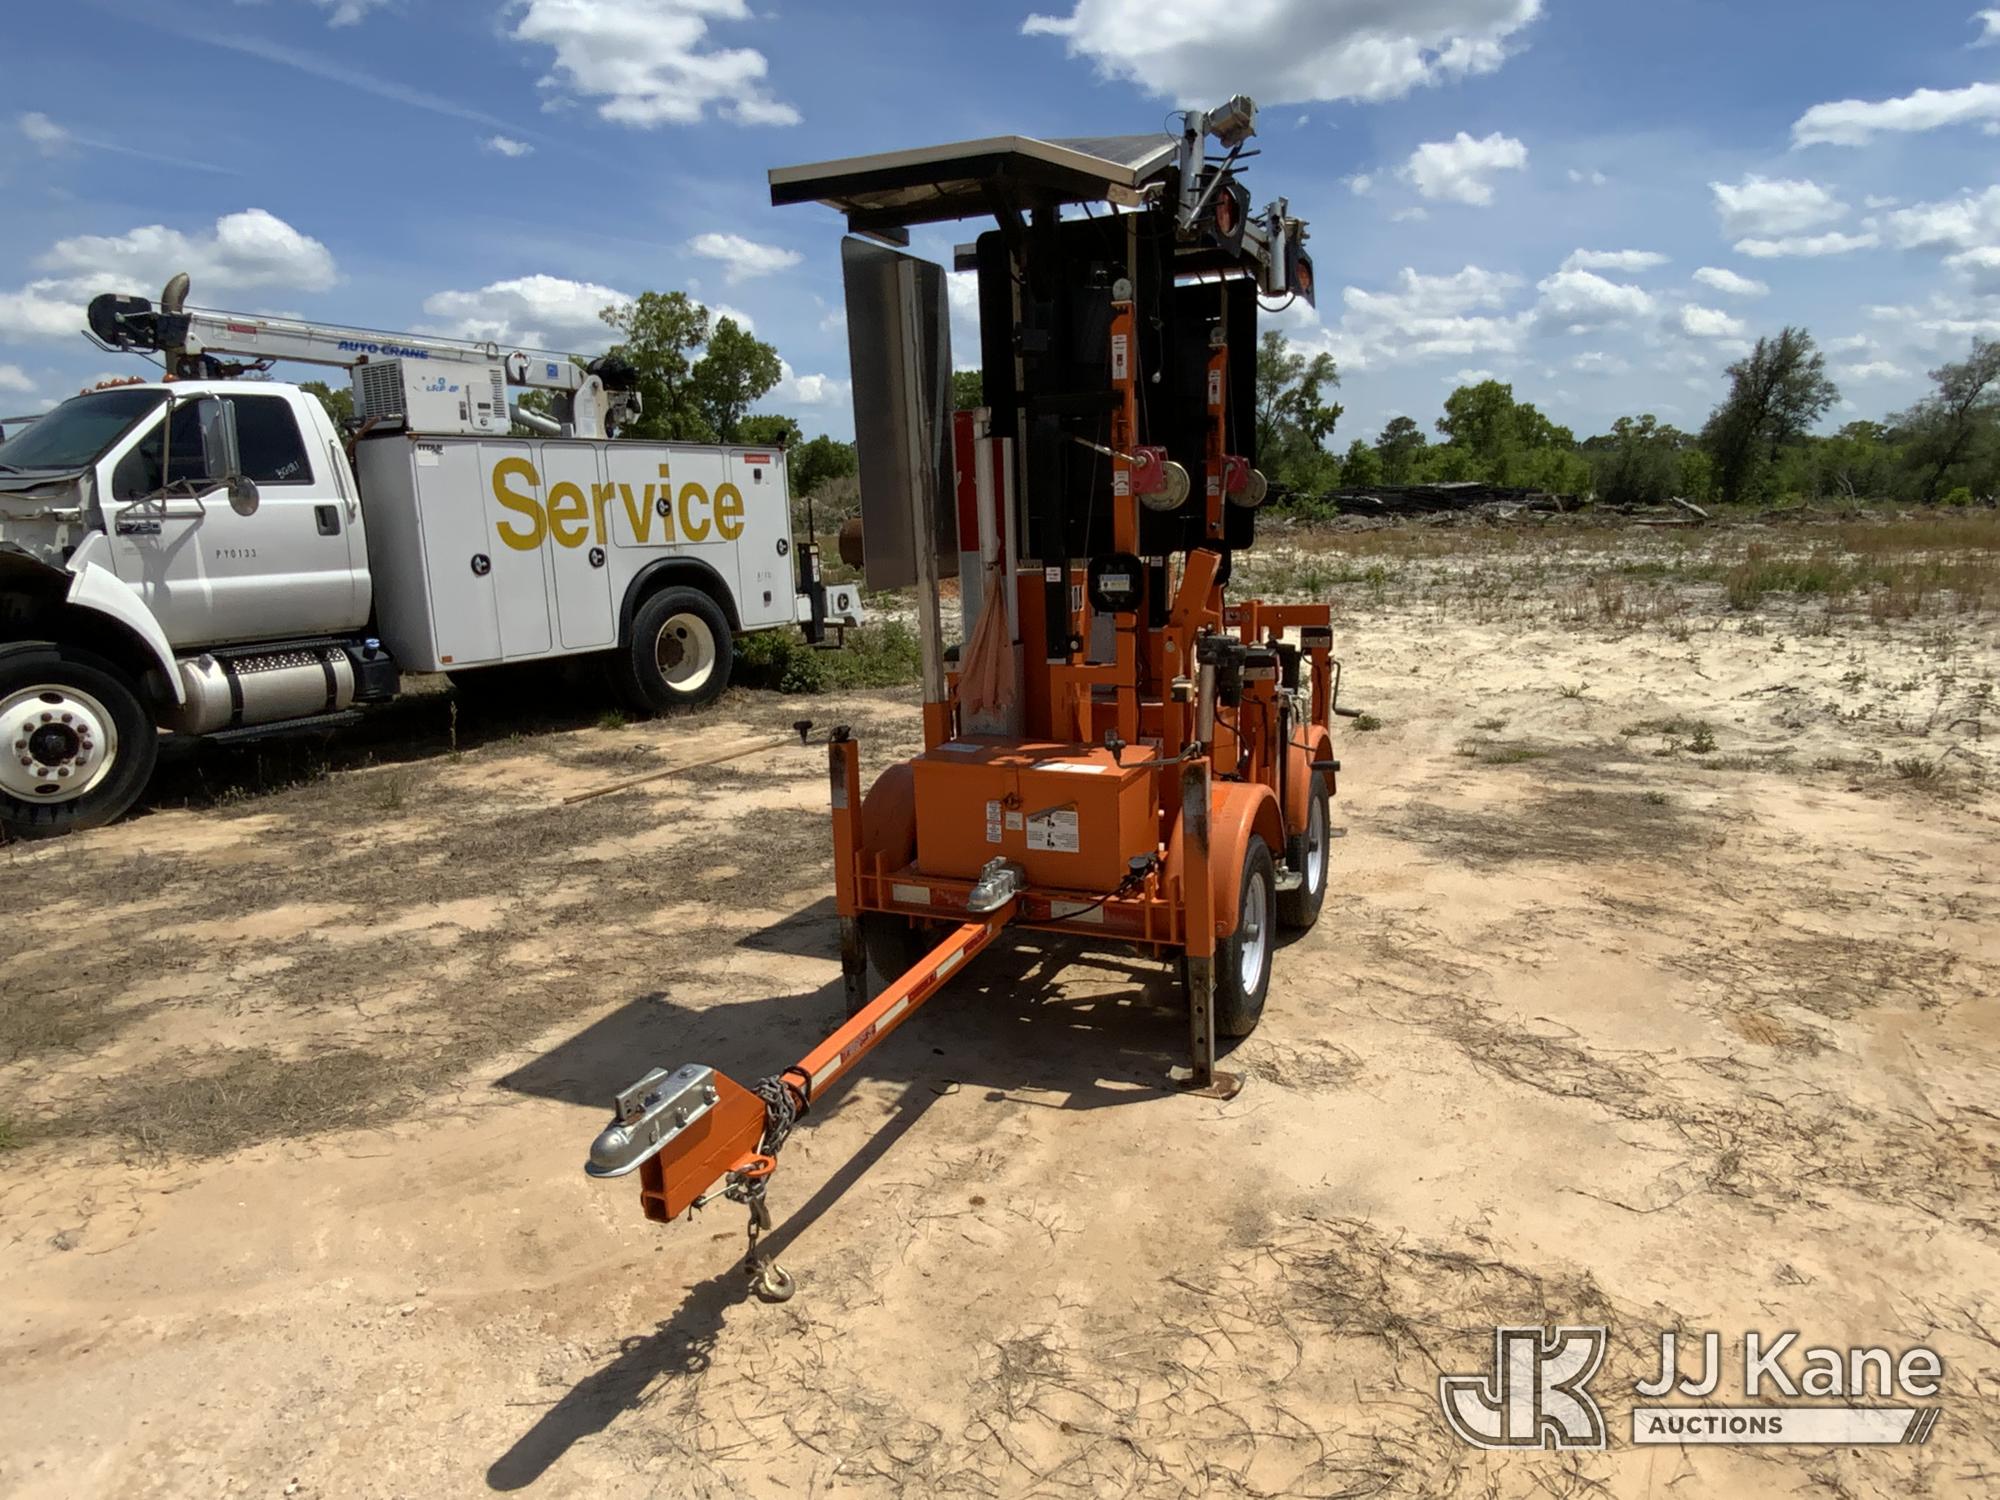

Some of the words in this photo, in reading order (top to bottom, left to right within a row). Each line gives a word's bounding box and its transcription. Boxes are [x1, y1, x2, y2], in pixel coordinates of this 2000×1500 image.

[338, 341, 379, 354] AUTO
[380, 345, 429, 359] CRANE
[492, 457, 745, 551] Service
